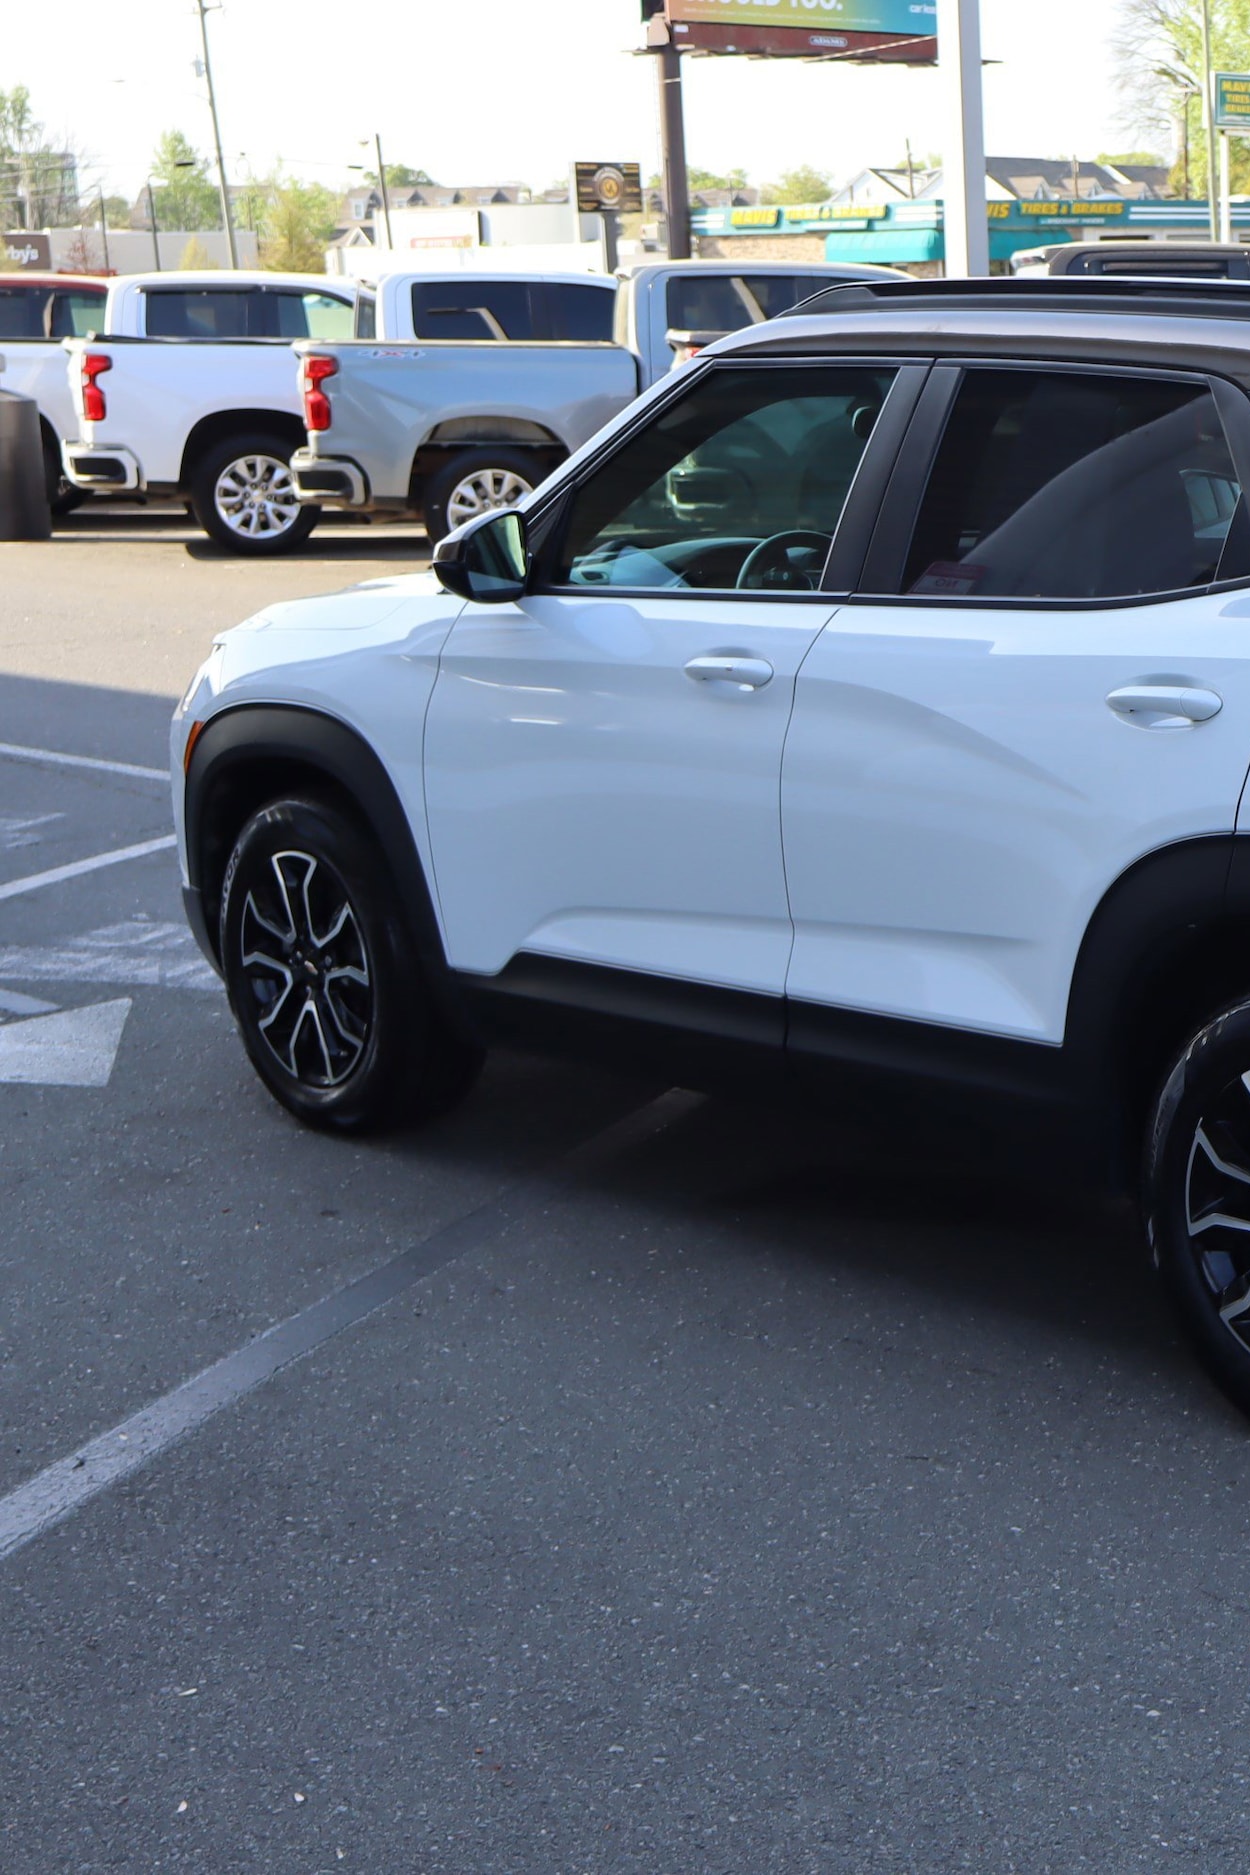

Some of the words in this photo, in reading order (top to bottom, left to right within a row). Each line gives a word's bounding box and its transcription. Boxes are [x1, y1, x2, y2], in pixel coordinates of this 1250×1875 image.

[731, 208, 778, 226] MAVIS
[986, 202, 1010, 218] VIS
[1021, 203, 1059, 215] TIRES
[1071, 202, 1124, 215] BRAKES
[5, 244, 39, 265] rby's
